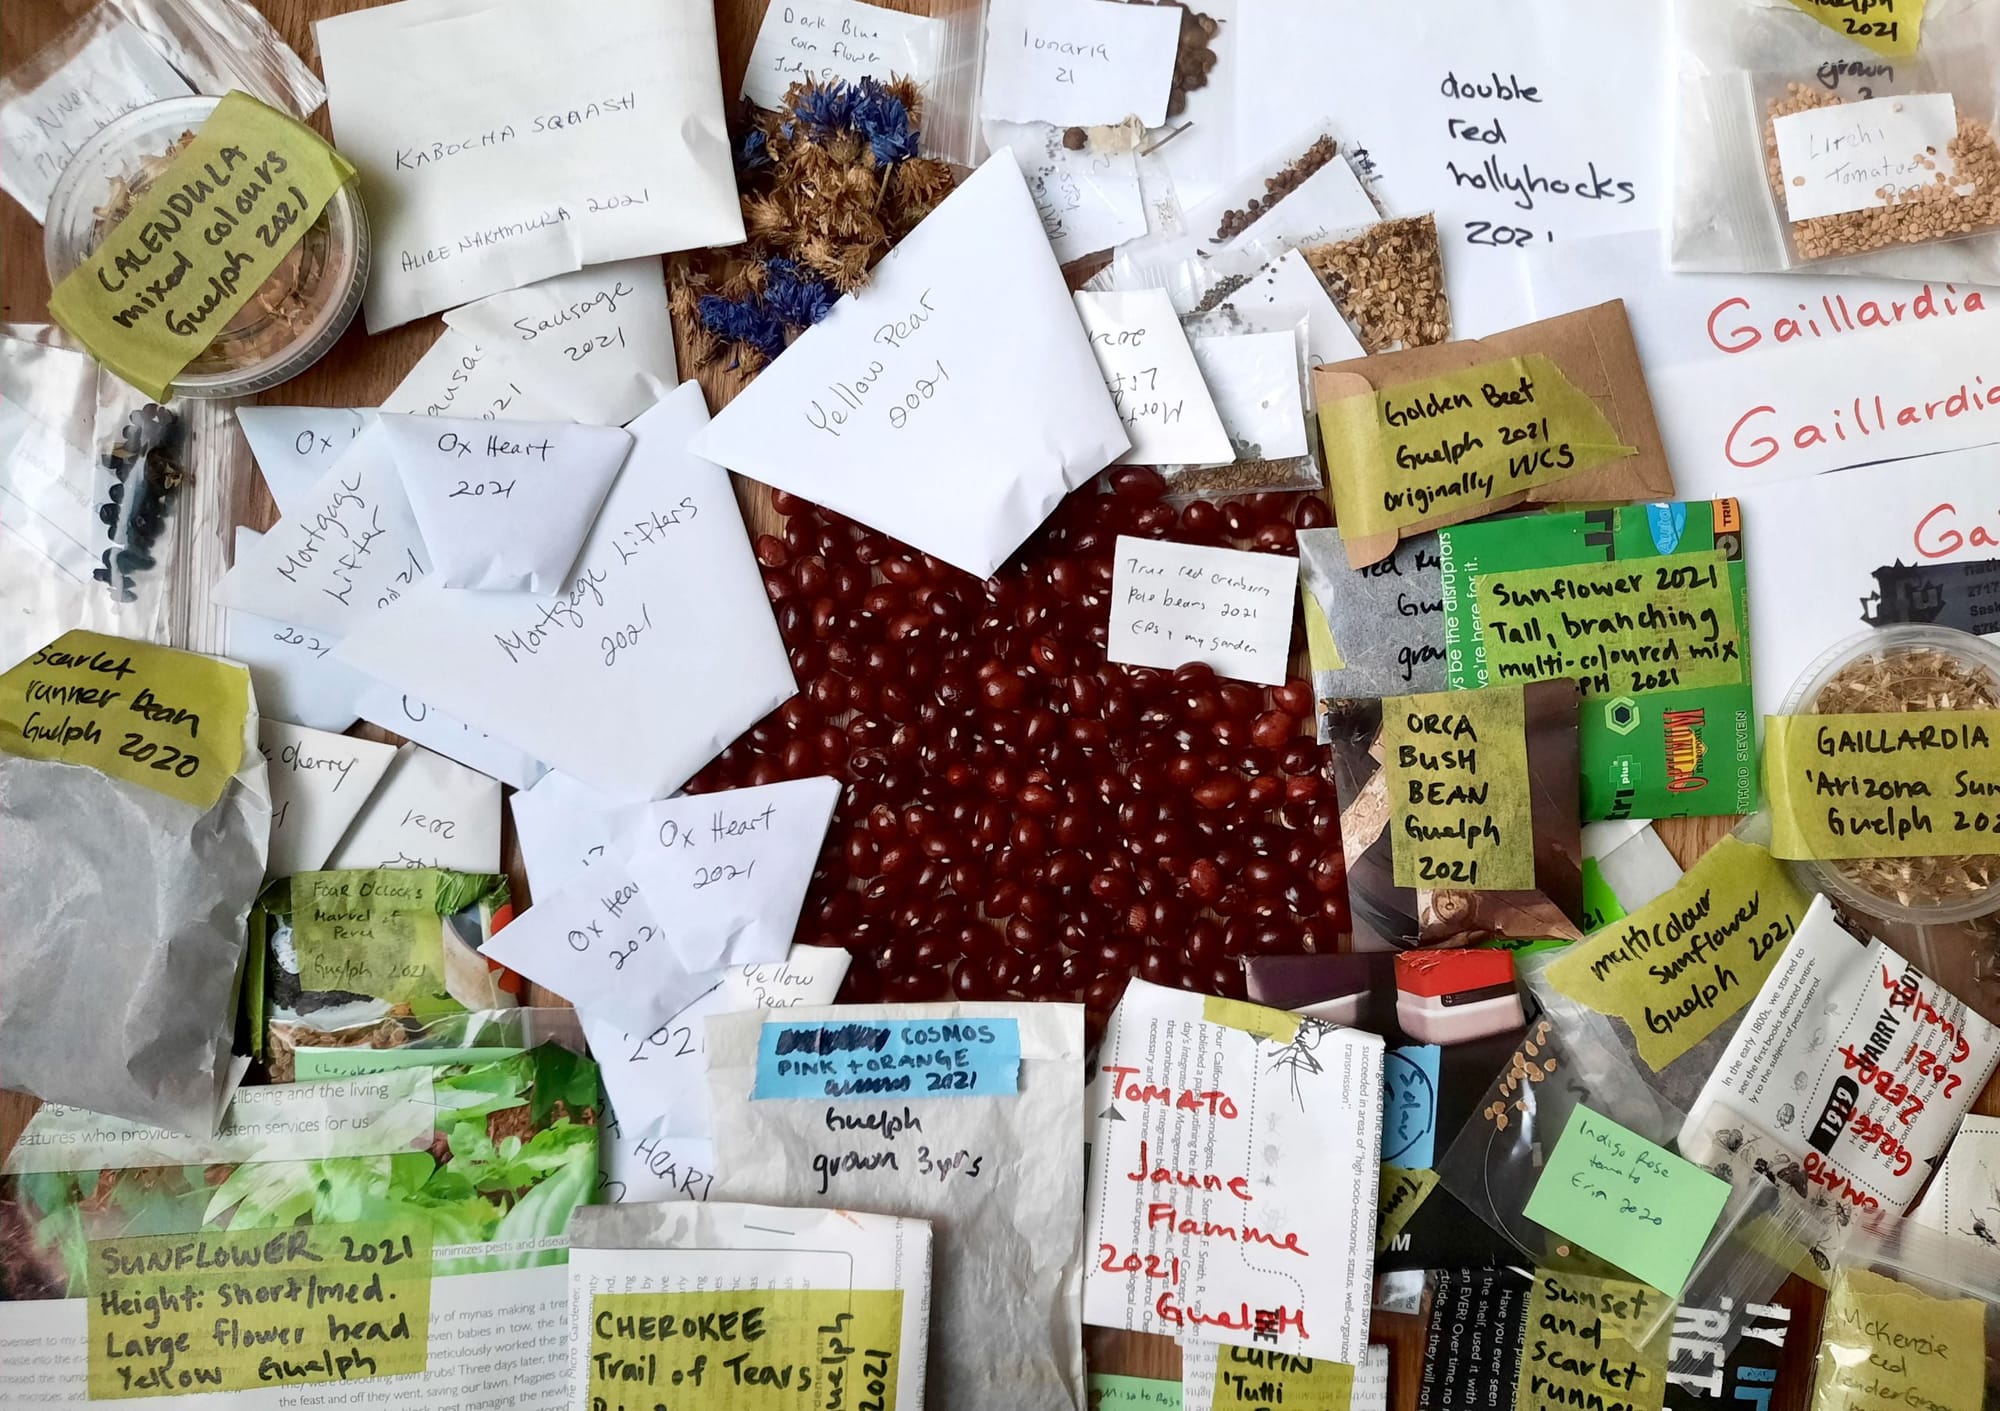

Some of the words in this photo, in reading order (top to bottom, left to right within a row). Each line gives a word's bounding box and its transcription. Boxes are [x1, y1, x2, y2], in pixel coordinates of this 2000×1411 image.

[784, 7, 827, 29] Dark
[842, 18, 880, 39] Blue
[1842, 18, 1898, 42] 2021
[1024, 28, 1110, 62] lunaria
[1055, 67, 1075, 84] 21
[1441, 71, 1543, 103] double
[1816, 59, 1894, 90] grown
[395, 124, 516, 171] KABOCHA
[1448, 117, 1507, 144] red
[1446, 153, 1636, 210] hollyhocks
[99, 146, 248, 293] CALENDULA
[458, 206, 572, 253] NAKAMURA
[588, 188, 650, 214] 2021
[1465, 220, 1554, 248] 2021
[112, 251, 195, 329] mixed
[204, 150, 289, 247] colours
[165, 250, 254, 337] Guelph
[256, 187, 310, 249] 2021
[513, 281, 634, 341] Sausage
[1707, 284, 1986, 354] Gaillardia
[563, 326, 627, 362] 2021
[805, 360, 884, 437] Yellow
[873, 287, 935, 348] Pear
[1384, 391, 1473, 428] Golden
[1481, 377, 1535, 408] Beet
[296, 429, 333, 456] Ox
[438, 433, 472, 458] Ox
[486, 434, 556, 461] Heart
[1396, 432, 1484, 471] Guelph
[1498, 418, 1550, 445] 2021
[449, 479, 517, 500] 2021
[1384, 471, 1494, 515] originally
[1509, 443, 1575, 480] WCS
[1439, 532, 1458, 612] disruptors
[1491, 571, 1643, 607] Sunflower
[1655, 564, 1719, 591] 2021
[1221, 603, 1257, 619] 2021
[1488, 616, 1557, 649] Tall,
[1561, 602, 1720, 642] branching
[273, 627, 333, 659] 2021
[600, 602, 653, 667] 2021
[1445, 615, 1460, 645] the
[31, 644, 137, 681] Scarlet
[1448, 649, 1463, 672] be
[1499, 638, 1680, 680] multi-coloured
[1688, 640, 1740, 663] mix
[1631, 667, 1681, 692] 2021
[24, 680, 122, 709] runner
[129, 687, 201, 739] bean
[1406, 711, 1478, 743] ORCA
[21, 711, 104, 747] Guelph
[117, 732, 201, 779] 2020
[1735, 709, 1749, 763] SEVEN
[1817, 724, 1990, 757] GAILLARDIA
[1400, 745, 1477, 776] BUSH
[1620, 759, 1630, 786] plus
[1408, 780, 1489, 807] BEAN
[659, 819, 696, 849] Ox
[710, 803, 778, 844] Heart
[1404, 815, 1501, 849] Guelph
[1827, 804, 1933, 842] Guelph
[692, 859, 758, 890] 2021
[1418, 856, 1478, 885] 2021
[567, 919, 604, 952] Ox
[1747, 914, 1798, 962] 2021
[1644, 964, 1741, 1035] Guelph
[1731, 1060, 1744, 1076] the
[1742, 1036, 1757, 1059] early
[1777, 958, 1799, 991] started
[900, 1025, 996, 1047] COSMOS
[1738, 1080, 1751, 1096] see
[1746, 1065, 1759, 1080] the
[1764, 1020, 1784, 1047] books
[1779, 984, 1803, 1020] devoted
[778, 1059, 839, 1076] PINK
[1761, 1068, 1773, 1084] the
[1769, 1037, 1788, 1070] subject
[320, 1083, 345, 1099] the
[350, 1081, 390, 1101] living
[926, 1071, 978, 1092] 2021
[264, 1118, 320, 1137] services
[325, 1116, 348, 1131] for
[826, 1106, 924, 1141] Guelph
[1580, 1120, 1628, 1158] Indigo
[1635, 1150, 1670, 1179] Rose
[812, 1150, 900, 1195] grown
[1127, 1139, 1254, 1202] Jaune
[1571, 1171, 1609, 1201] Erin
[1619, 1198, 1663, 1227] 2020
[1147, 1202, 1310, 1257] Flamme
[339, 1234, 414, 1266] 2021
[1099, 1243, 1181, 1286] 2021
[1481, 1276, 1495, 1296] the
[1498, 1288, 1512, 1319] Have
[1543, 1277, 1649, 1320] Sunset
[100, 1284, 205, 1329] Height:
[106, 1331, 191, 1372] Large
[212, 1317, 305, 1350] flower
[328, 1312, 410, 1343] head
[595, 1307, 766, 1343] CHEROKEE
[1449, 1323, 1464, 1354] Over
[1494, 1321, 1507, 1344] you
[1540, 1313, 1602, 1350] and
[1424, 1331, 1441, 1361] they
[1471, 1331, 1482, 1361] used
[1491, 1347, 1503, 1376] ever
[116, 1364, 223, 1391] Yellow
[258, 1347, 377, 1382] Guelph
[592, 1354, 656, 1386] Trail
[672, 1354, 708, 1387] of
[723, 1352, 812, 1393] Tears
[1465, 1377, 1479, 1405] with
[1488, 1378, 1499, 1407] seen
